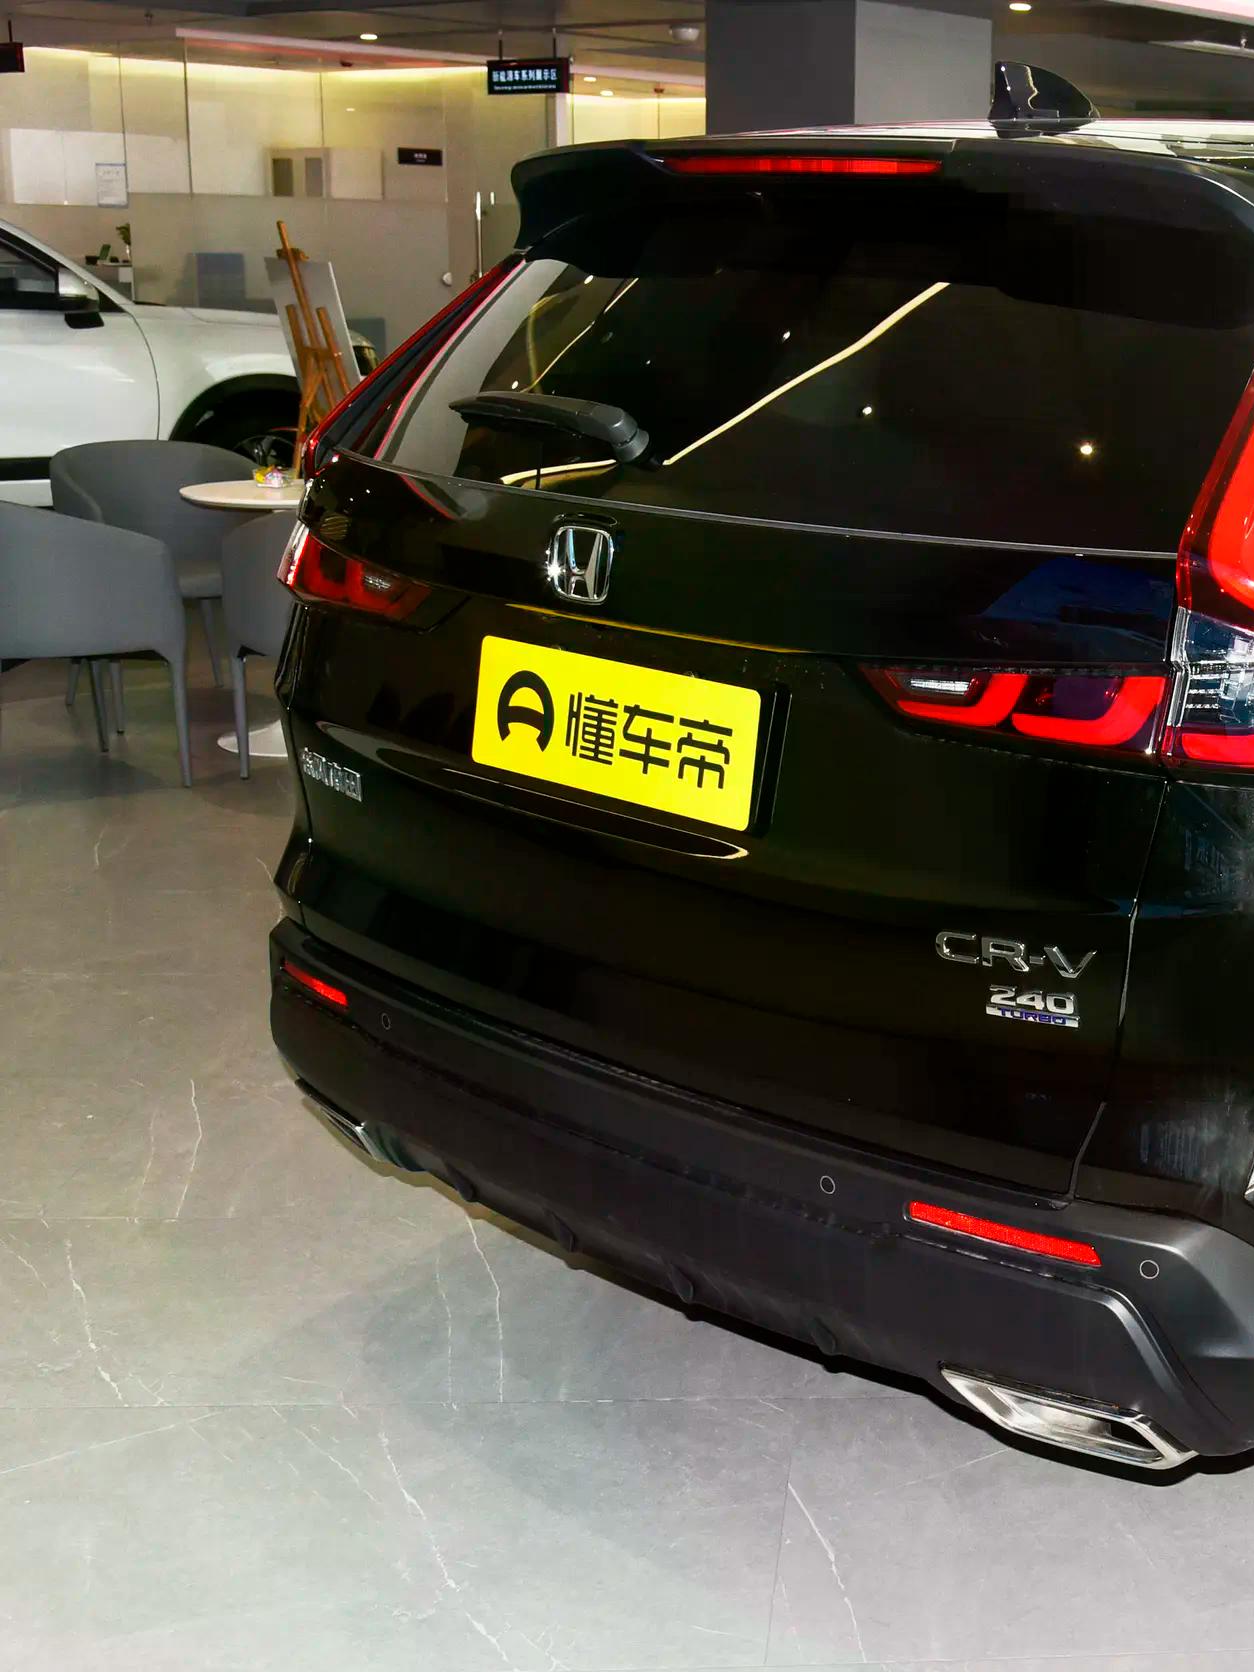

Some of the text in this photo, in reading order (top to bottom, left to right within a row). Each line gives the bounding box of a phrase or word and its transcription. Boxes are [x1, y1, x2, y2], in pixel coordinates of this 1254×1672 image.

[564, 691, 733, 790] 懂车帝
[935, 930, 1098, 979] CR-V
[989, 984, 1076, 1015] 240
[997, 1006, 1068, 1026] TURBO
